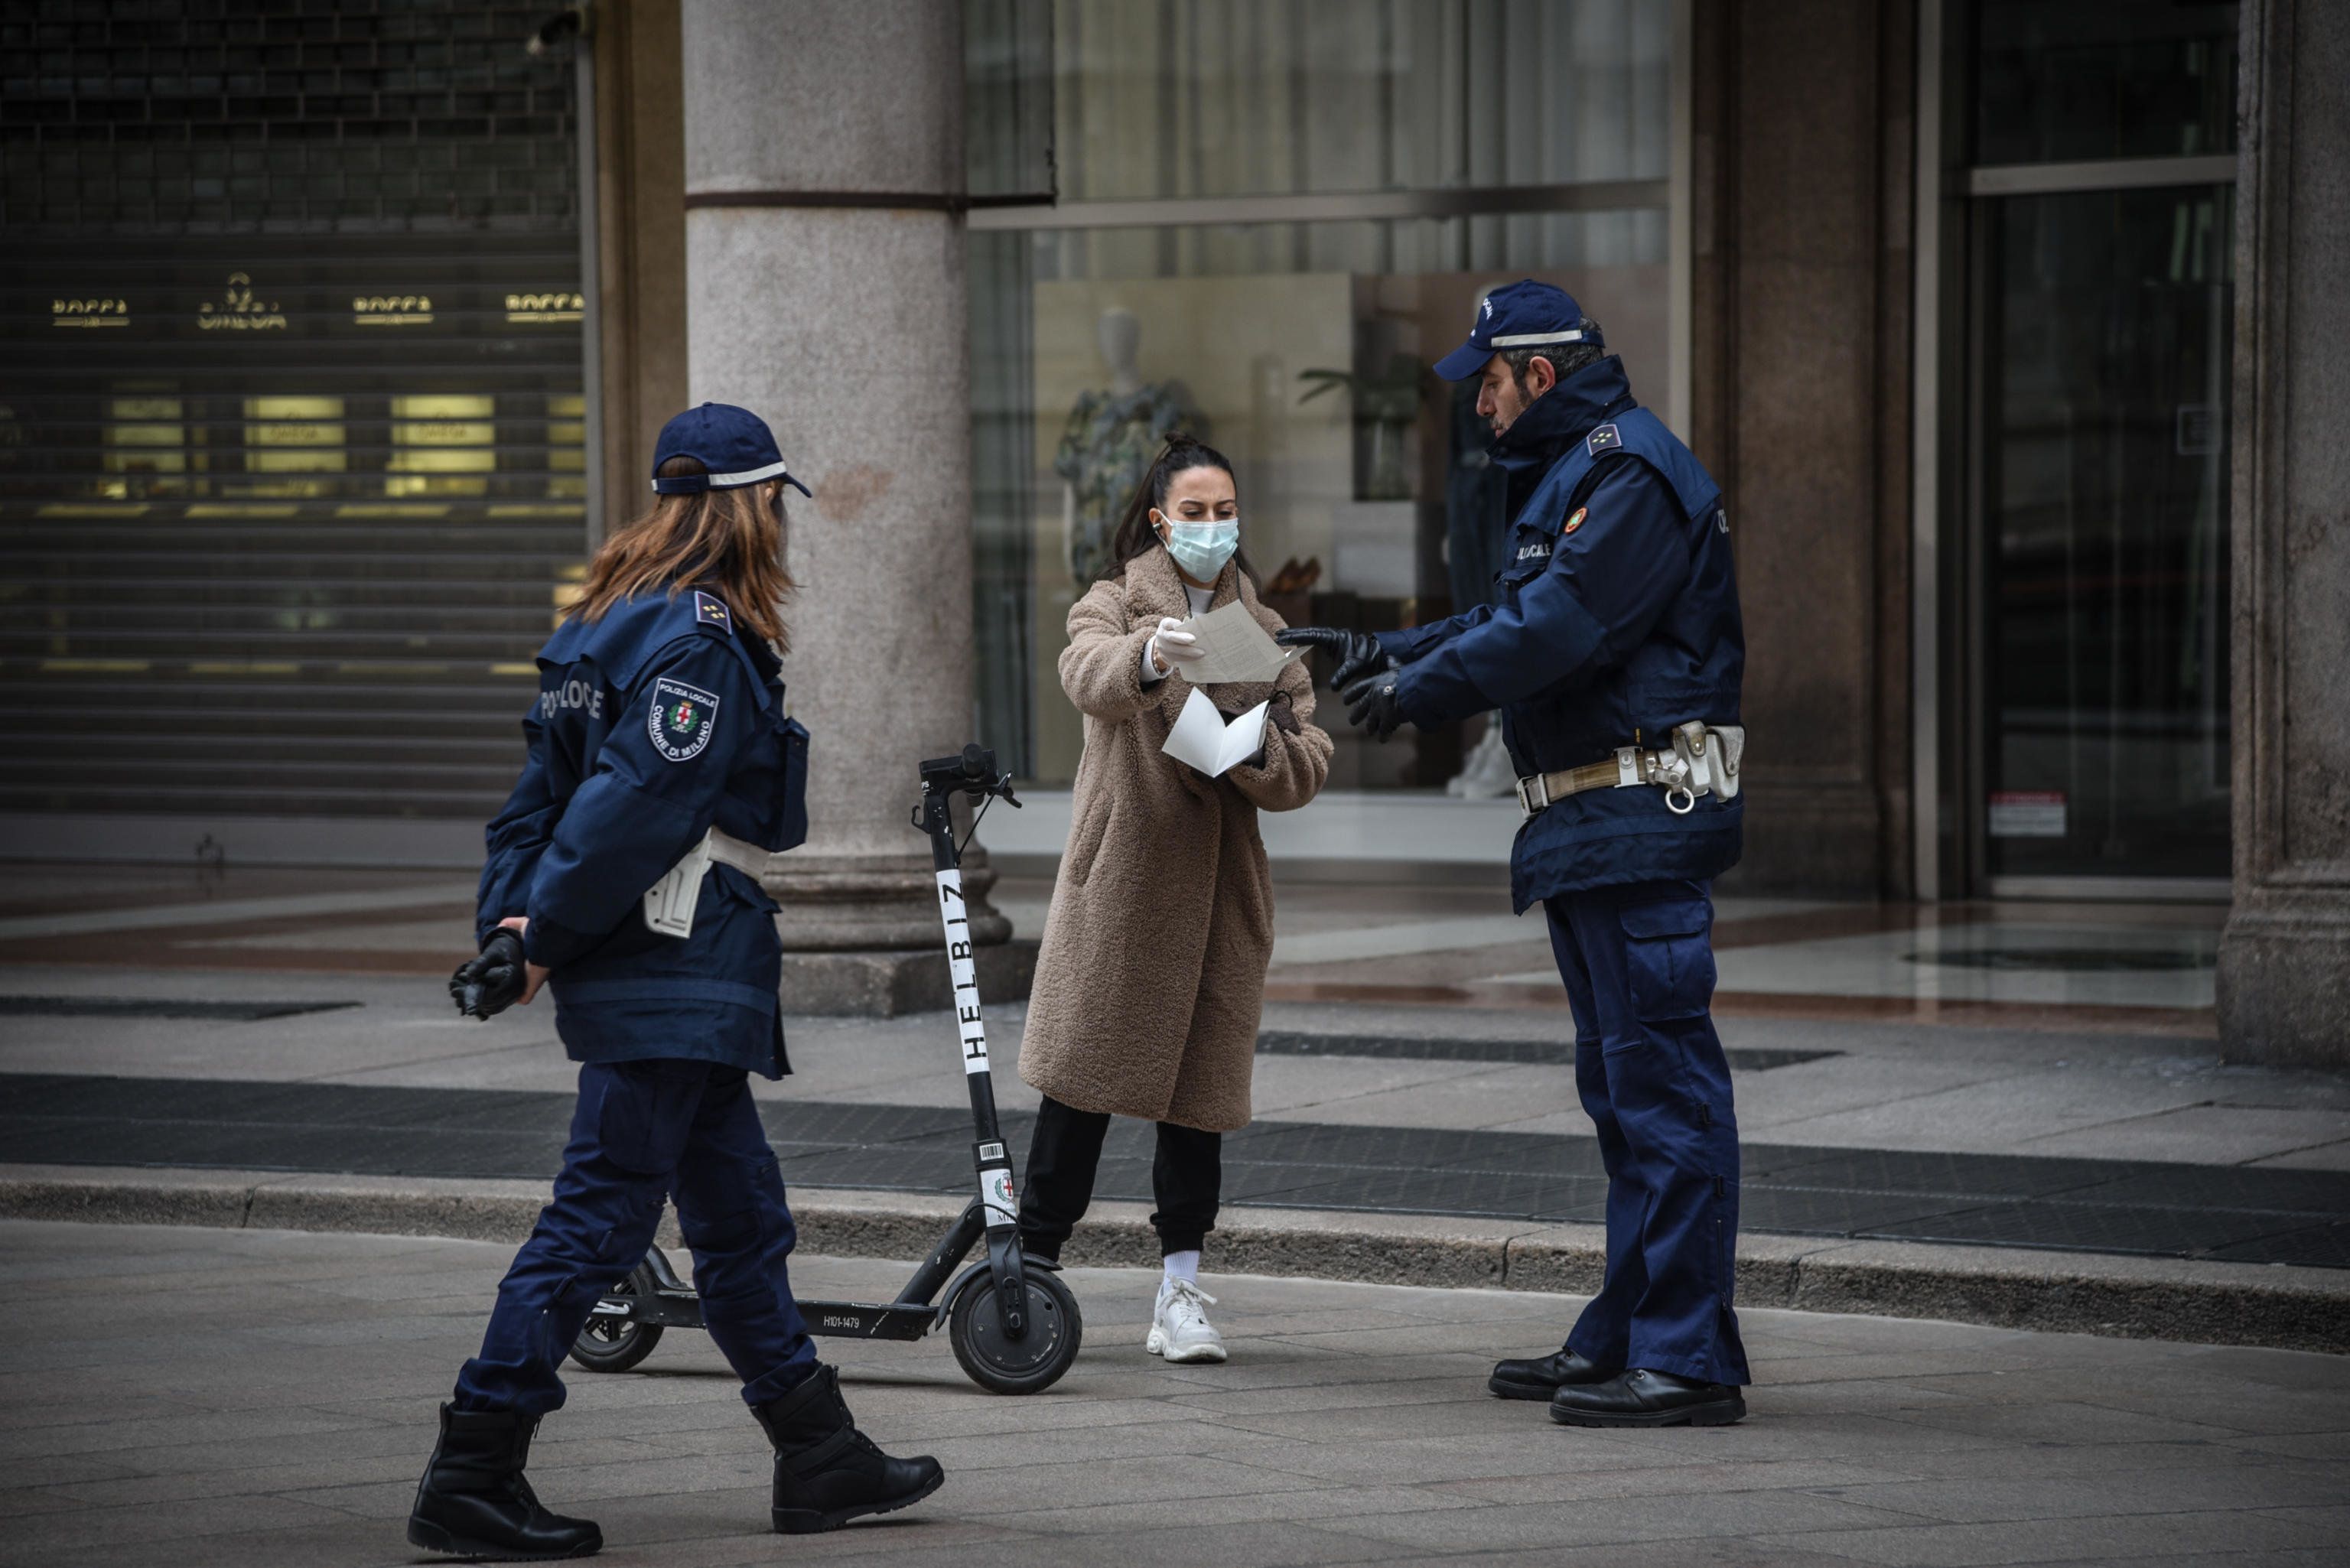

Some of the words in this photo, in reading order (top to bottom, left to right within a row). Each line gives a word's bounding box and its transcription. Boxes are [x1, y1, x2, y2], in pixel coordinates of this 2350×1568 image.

[659, 684, 688, 698] POLIZIA
[689, 692, 716, 708] LOCALE
[652, 704, 670, 750] COMUNE
[668, 747, 679, 757] DI
[681, 721, 710, 756] MILANO
[942, 882, 987, 1060] HELBIZ
[823, 1315, 860, 1329] H101-1479
